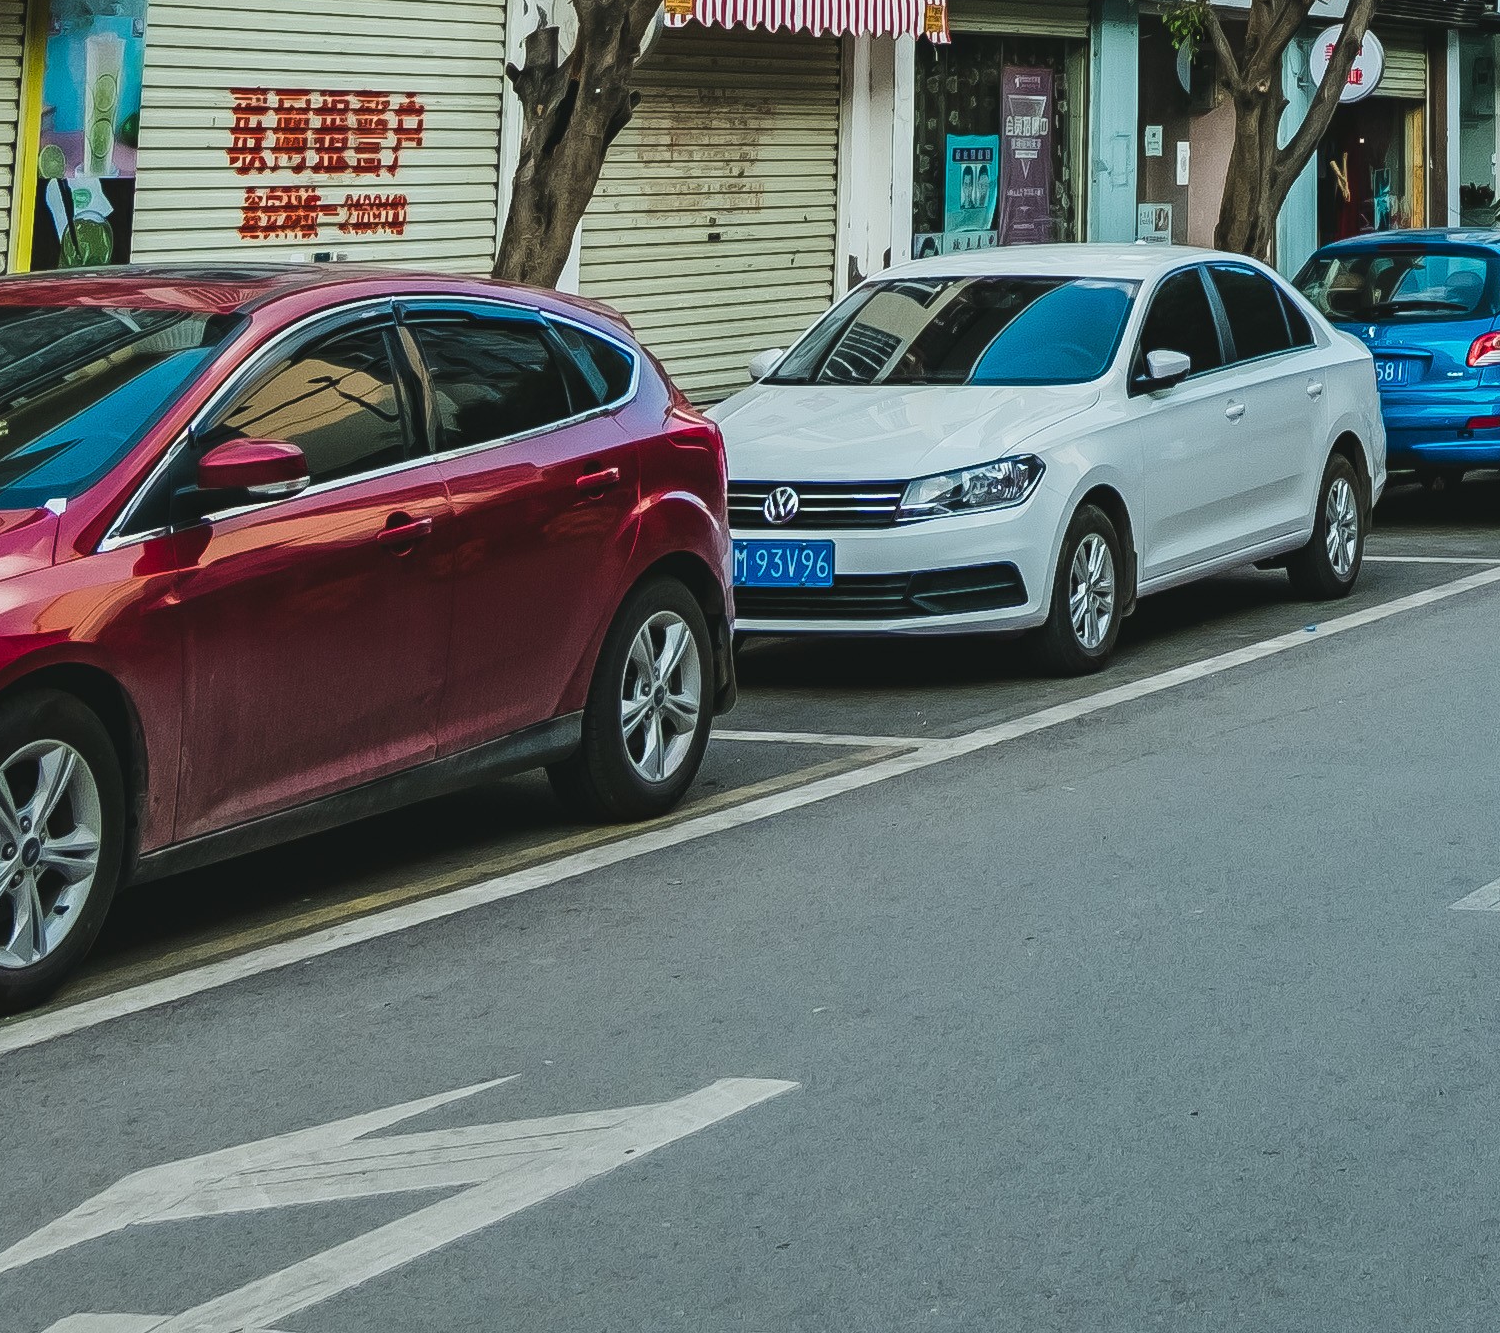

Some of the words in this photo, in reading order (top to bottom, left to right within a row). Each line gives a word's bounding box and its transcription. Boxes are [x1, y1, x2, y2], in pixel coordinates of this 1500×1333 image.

[225, 87, 425, 177] 联网报警户
